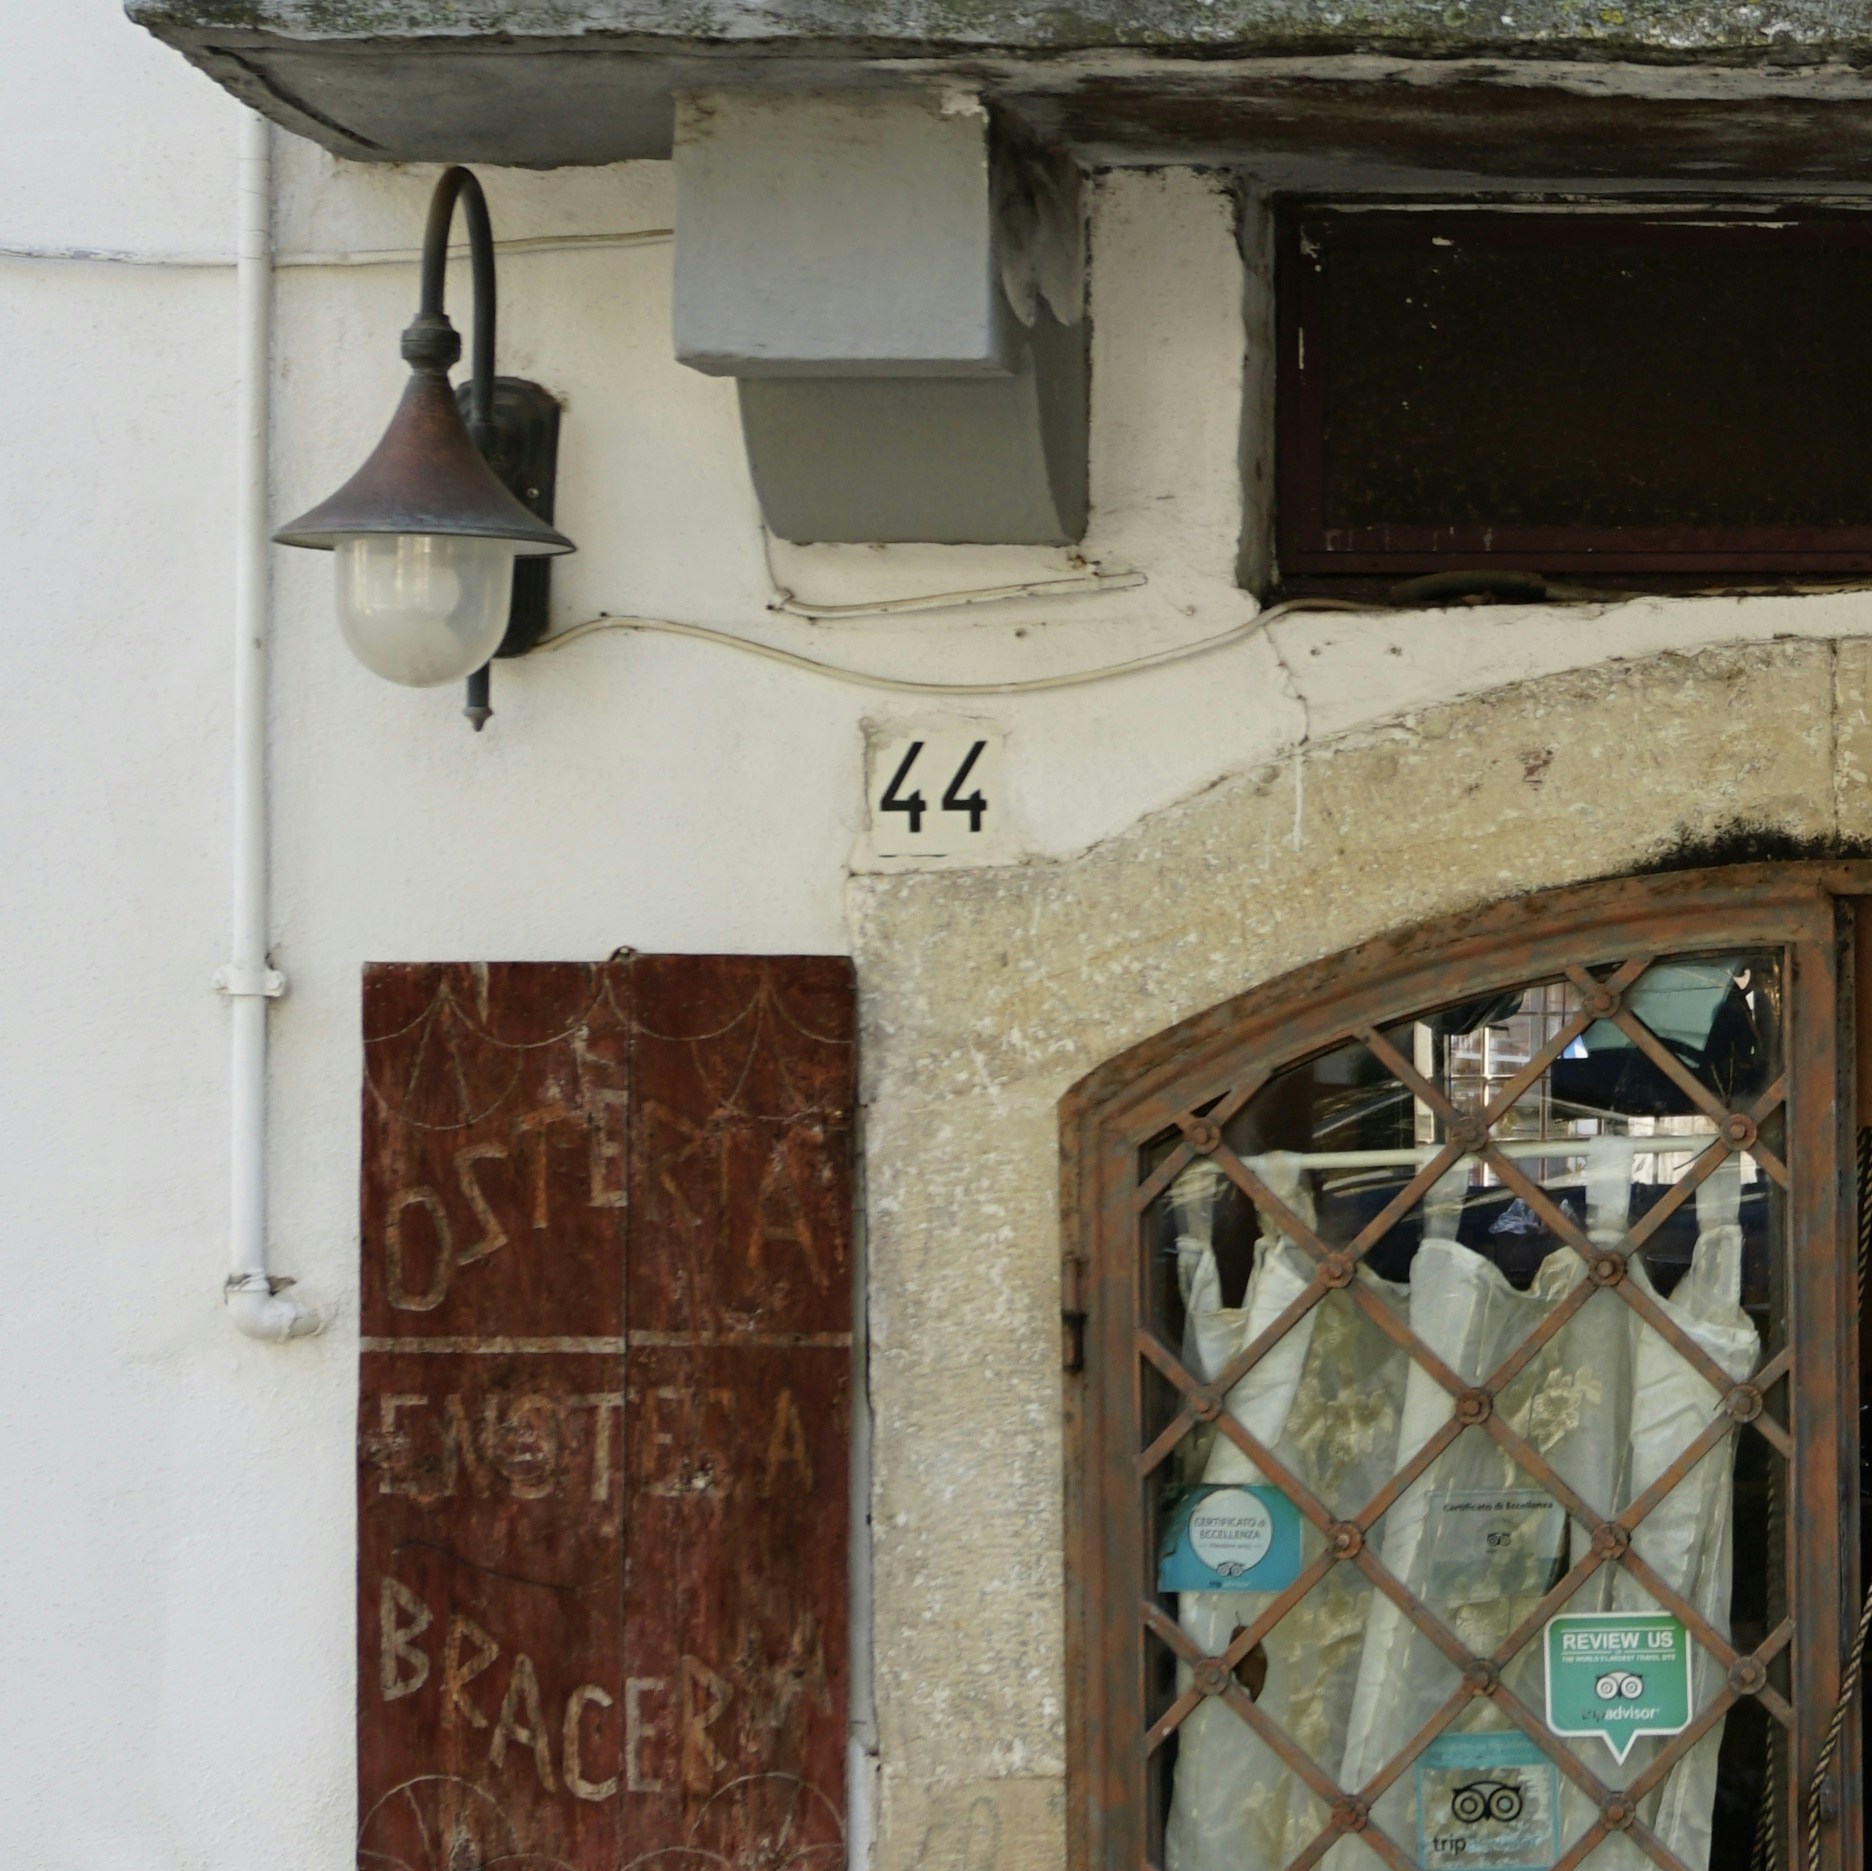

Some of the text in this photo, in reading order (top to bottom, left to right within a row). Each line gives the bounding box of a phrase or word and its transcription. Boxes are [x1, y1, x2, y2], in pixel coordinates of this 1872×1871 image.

[879, 739, 989, 833] 44
[385, 1089, 829, 1312] OSTERIA
[1194, 1516, 1255, 1528] CERTIFICATO
[1199, 1529, 1260, 1539] ECCELLENZA
[1562, 1631, 1674, 1650] REVIEW US
